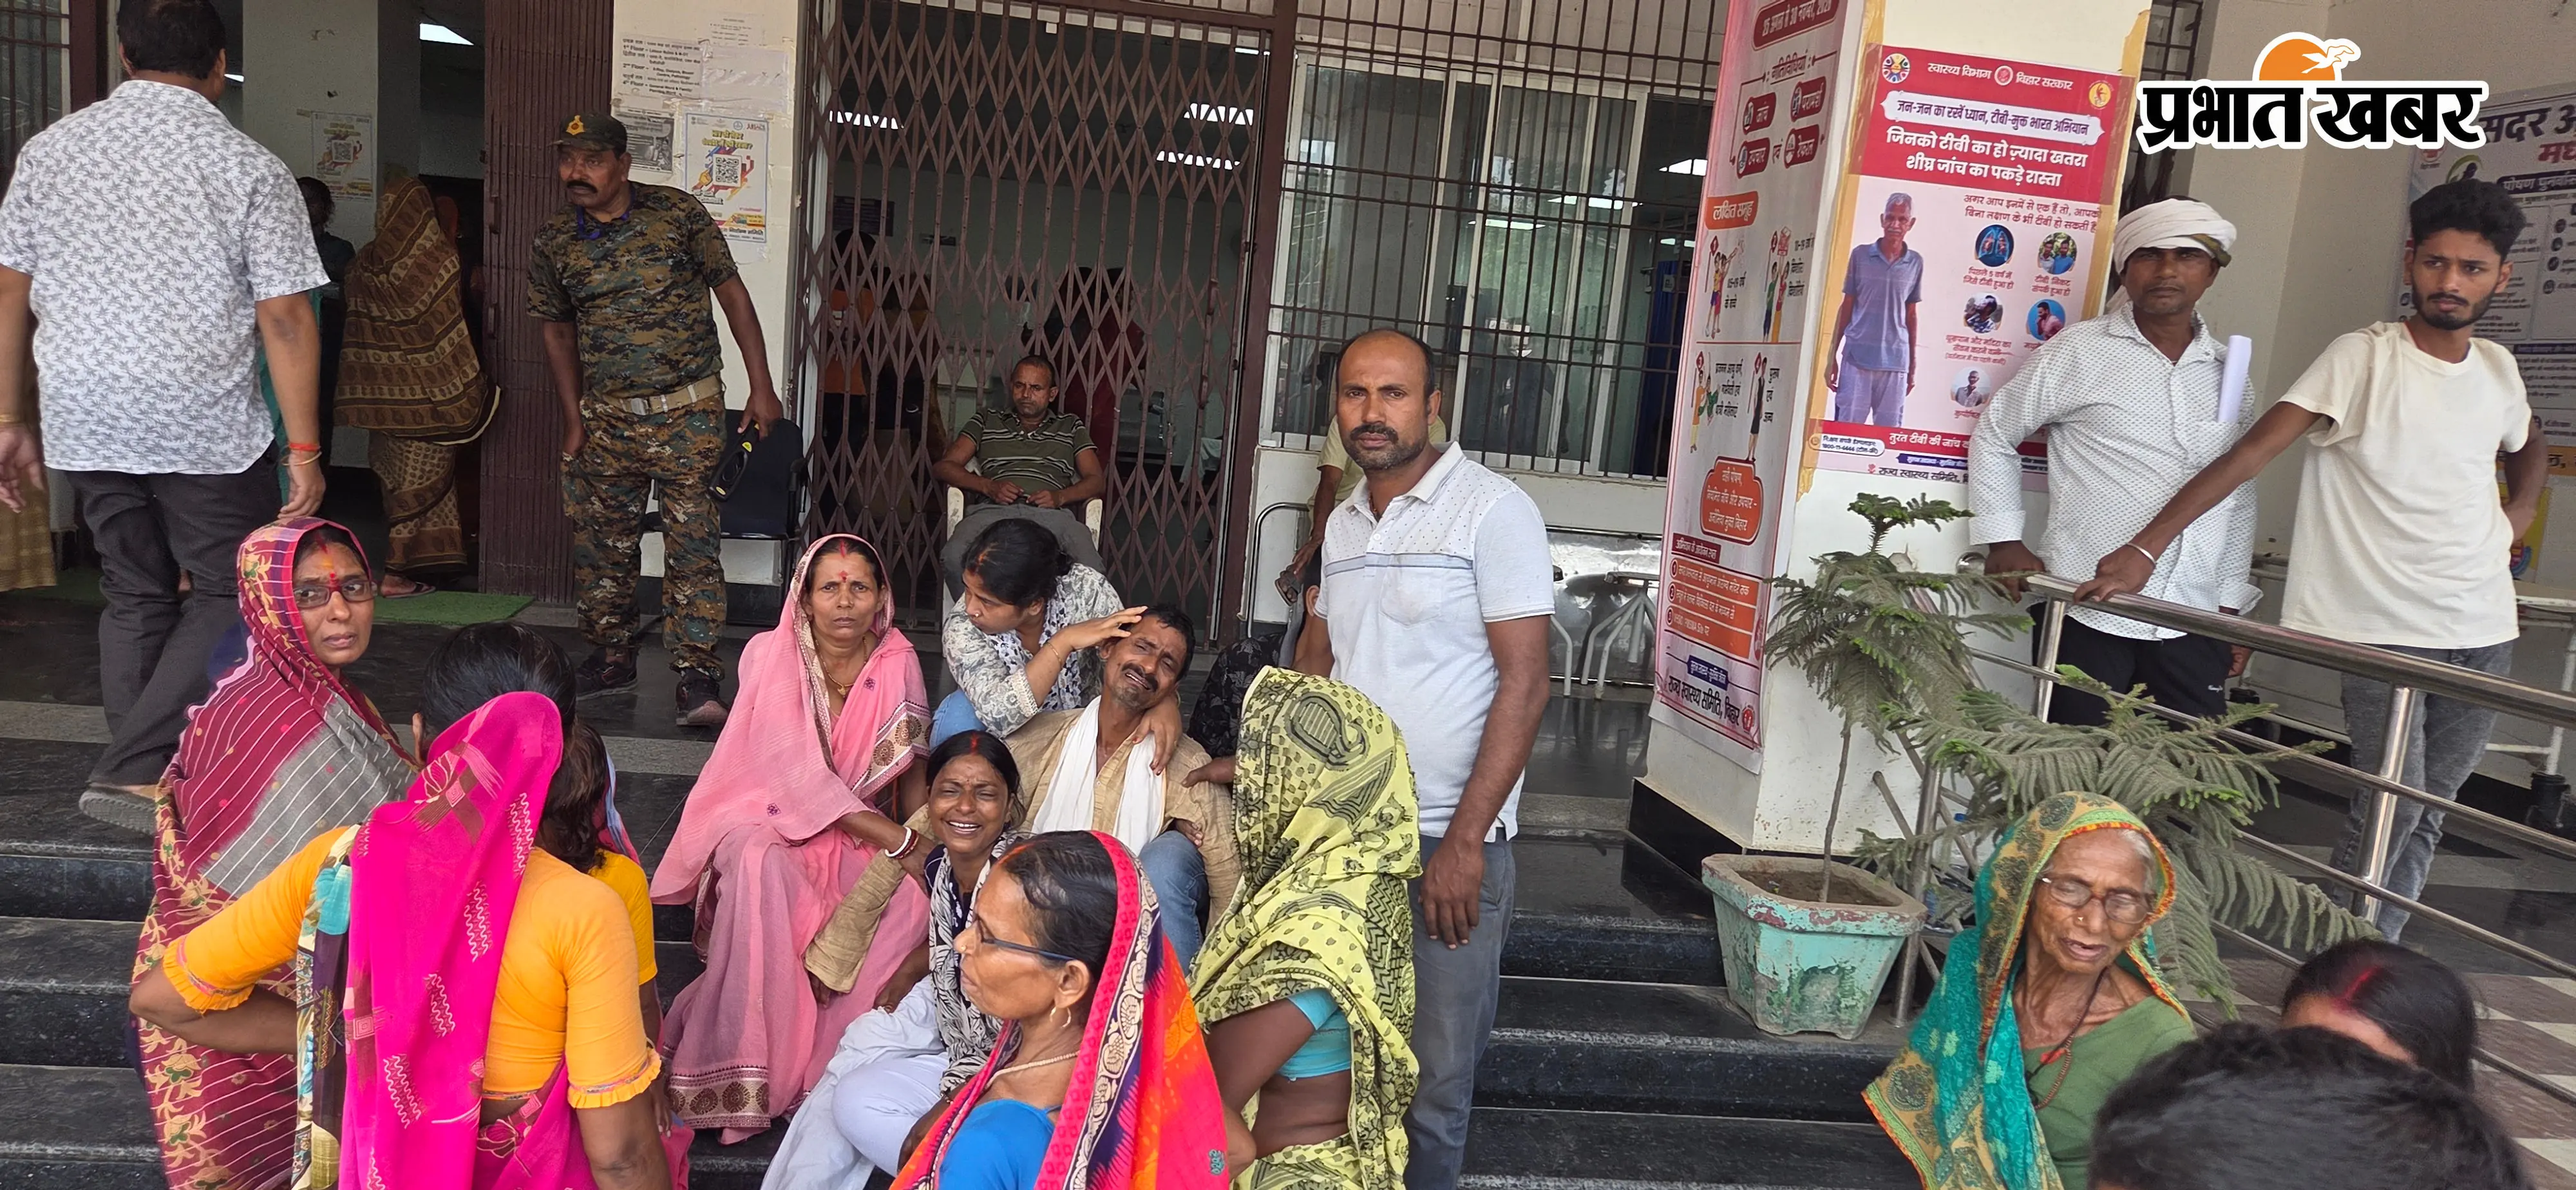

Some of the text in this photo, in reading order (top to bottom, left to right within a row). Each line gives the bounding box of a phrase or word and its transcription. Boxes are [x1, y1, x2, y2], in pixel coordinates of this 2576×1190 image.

[1927, 62, 2074, 91] स्वास्थ्य विभाग बिहार सरकार
[1897, 99, 2088, 137] जन-जन का रखें ध्यान, टीबी-मुक्त भारत अभियान
[2479, 108, 2552, 144] सदर
[1886, 127, 1937, 150] जिनको
[1939, 131, 1970, 153] टीबी
[1971, 140, 1991, 156] का
[1993, 139, 2007, 159] हो
[2050, 150, 2088, 169] खतरा
[1906, 152, 2063, 187] शीघ्र जांच का पकड़े रास्ता
[2503, 177, 2535, 191] पोषण
[1712, 199, 1754, 222] लक्षित समूह
[1964, 194, 1985, 205] अगर
[1985, 196, 2004, 207] आप
[2005, 198, 2025, 210] इनमें
[2026, 198, 2034, 211] से
[2036, 203, 2050, 212] एक
[2059, 203, 2072, 217] तो,
[2073, 207, 2102, 220] आपको
[1964, 205, 1985, 219] बिना
[1985, 209, 2011, 222] लक्षण
[2012, 211, 2022, 223] के
[2022, 212, 2033, 225] भी
[2034, 214, 2052, 227] टीबी
[2053, 216, 2063, 229] हो
[2064, 218, 2089, 232] सकती
[1978, 276, 1993, 287] टीबी
[1993, 280, 2006, 290] हुआ
[2006, 279, 2014, 290] हो
[1994, 269, 2005, 279] वर्ष
[2005, 269, 2013, 281] में
[2034, 274, 2050, 285] टीबी
[2050, 287, 2063, 298] हुआ
[2063, 287, 2071, 298] हो
[2002, 341, 2012, 349] का
[1888, 431, 1908, 445] तुरंत
[1909, 431, 1927, 446] टीबी
[1928, 434, 1941, 447] की
[1942, 437, 1960, 449] जांच
[1879, 467, 1899, 476] राज्य
[1900, 469, 1929, 480] स्वास्थ्य
[1734, 513, 1748, 531] बिहार
[1668, 675, 1681, 697] राज्य
[1681, 681, 1702, 706] स्वास्थ्य
[1724, 695, 1740, 727] बिहार
